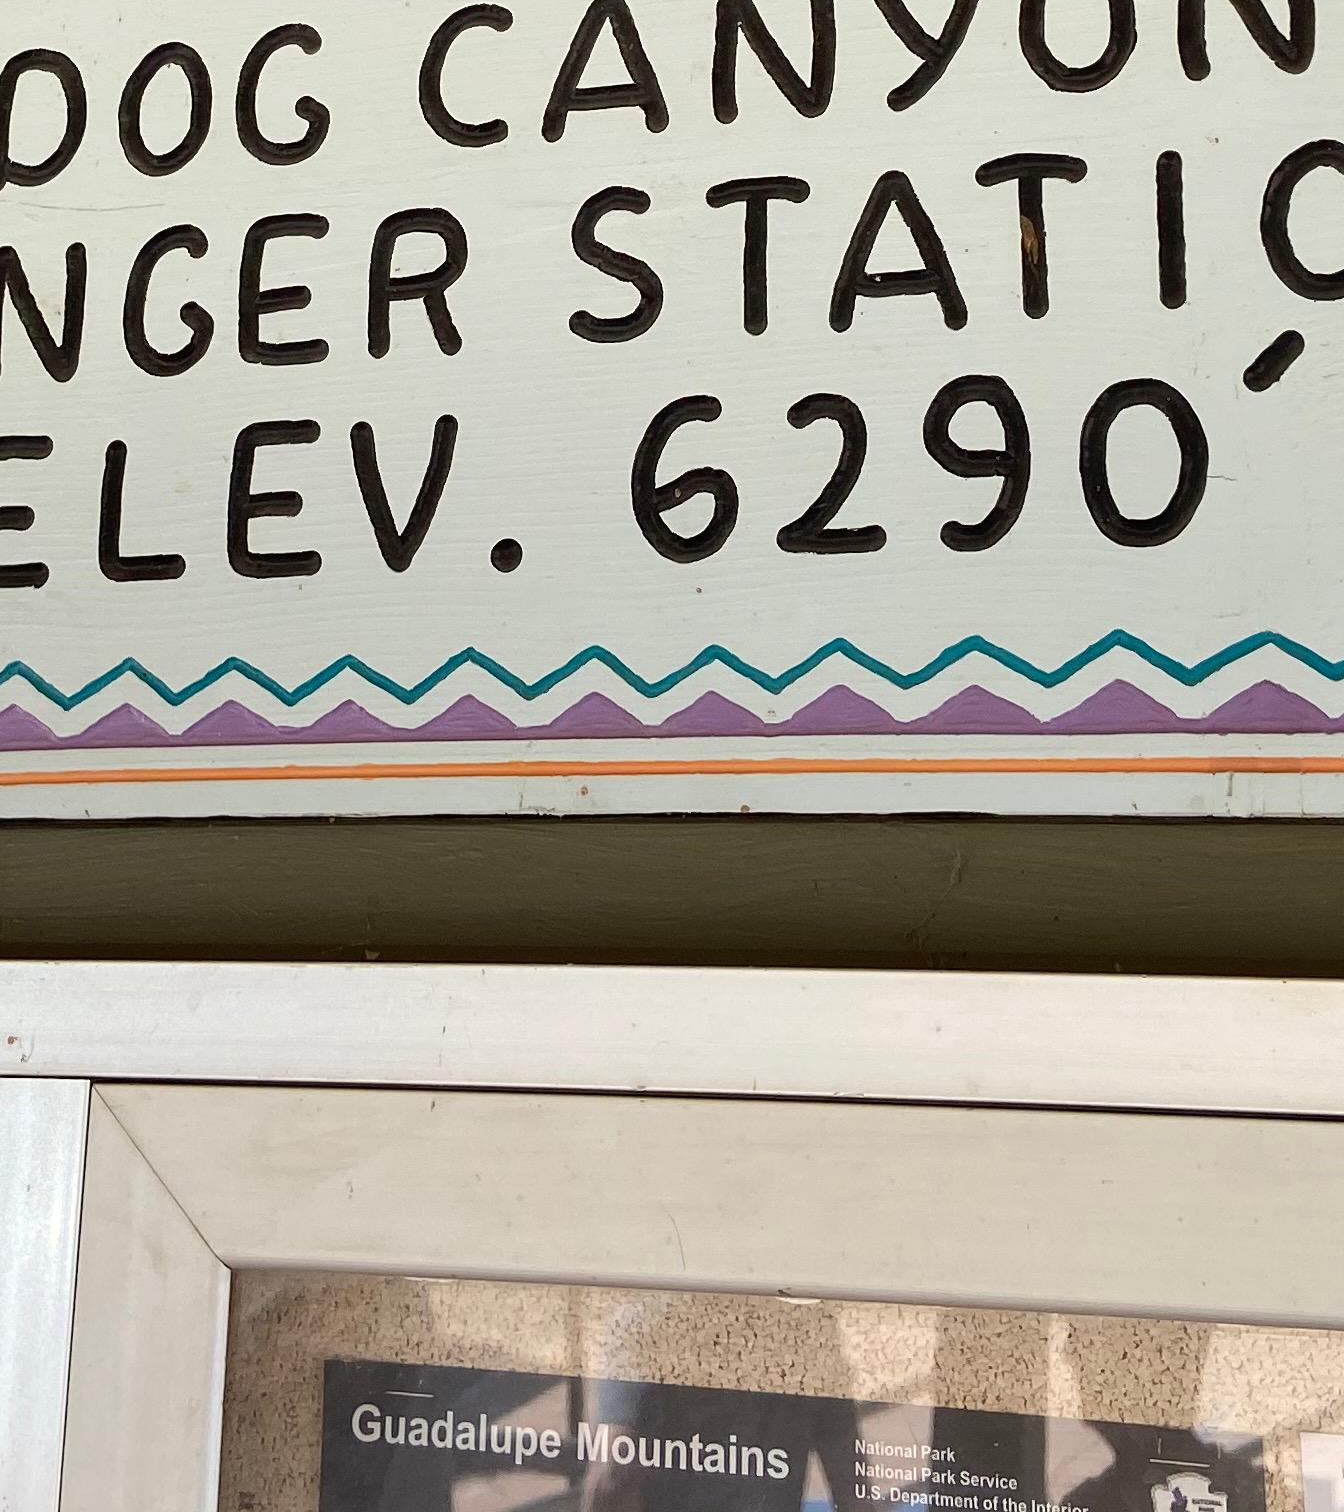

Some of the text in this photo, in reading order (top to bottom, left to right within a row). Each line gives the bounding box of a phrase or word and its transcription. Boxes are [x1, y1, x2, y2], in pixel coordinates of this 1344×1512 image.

[351, 1403, 791, 1480] Guadalupe Mountains
[855, 1439, 956, 1463] National Park
[855, 1461, 1018, 1490] National Park Service
[855, 1484, 886, 1502] U.S.
[890, 1487, 979, 1510] Department
[983, 1496, 999, 1511] of
[1002, 1497, 1027, 1512] the
